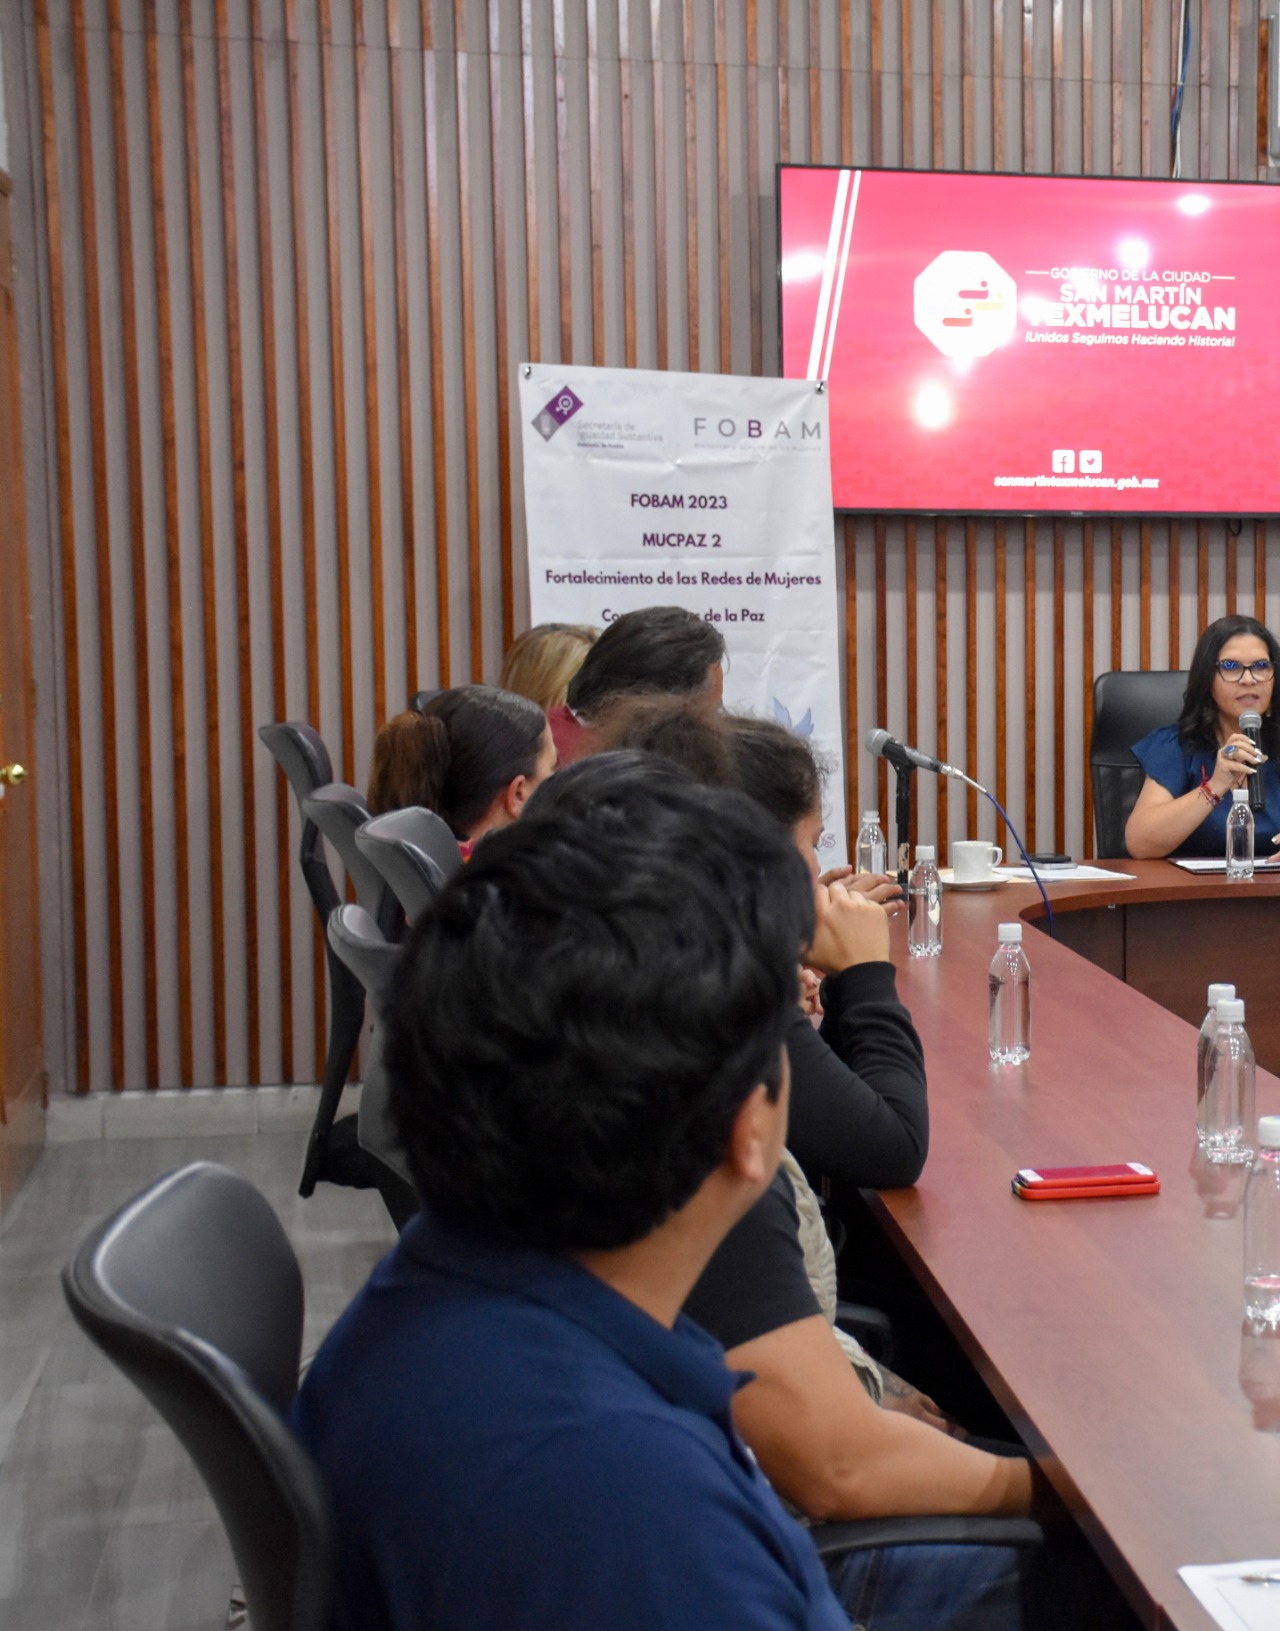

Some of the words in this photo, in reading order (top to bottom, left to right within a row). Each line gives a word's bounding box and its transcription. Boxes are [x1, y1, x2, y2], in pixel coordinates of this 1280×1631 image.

[1122, 270, 1139, 281] DE
[1142, 271, 1159, 282] LA
[1162, 271, 1211, 282] CIUDAD
[1060, 284, 1107, 303] SAN
[1114, 282, 1201, 305] MARTÍN
[1072, 332, 1128, 345] Seguimos
[1131, 333, 1185, 345] Haciendo
[1188, 335, 1235, 347] Historia!
[624, 422, 635, 431] de
[694, 417, 822, 440] FOBAM
[577, 430, 615, 441] Igualdad
[617, 431, 664, 442] Sustantiva
[630, 493, 684, 508] FOBAM
[688, 495, 728, 510] 2023
[642, 533, 707, 548] MUCPAZ
[712, 534, 722, 548] 2
[545, 570, 654, 584] Fortalecimiento
[656, 571, 673, 585] de
[677, 571, 697, 585] las
[701, 572, 742, 586] Redes
[746, 571, 762, 585] de
[764, 572, 822, 589] Mujeres
[704, 608, 721, 622] de
[725, 608, 737, 622] la
[741, 609, 765, 622] Paz
